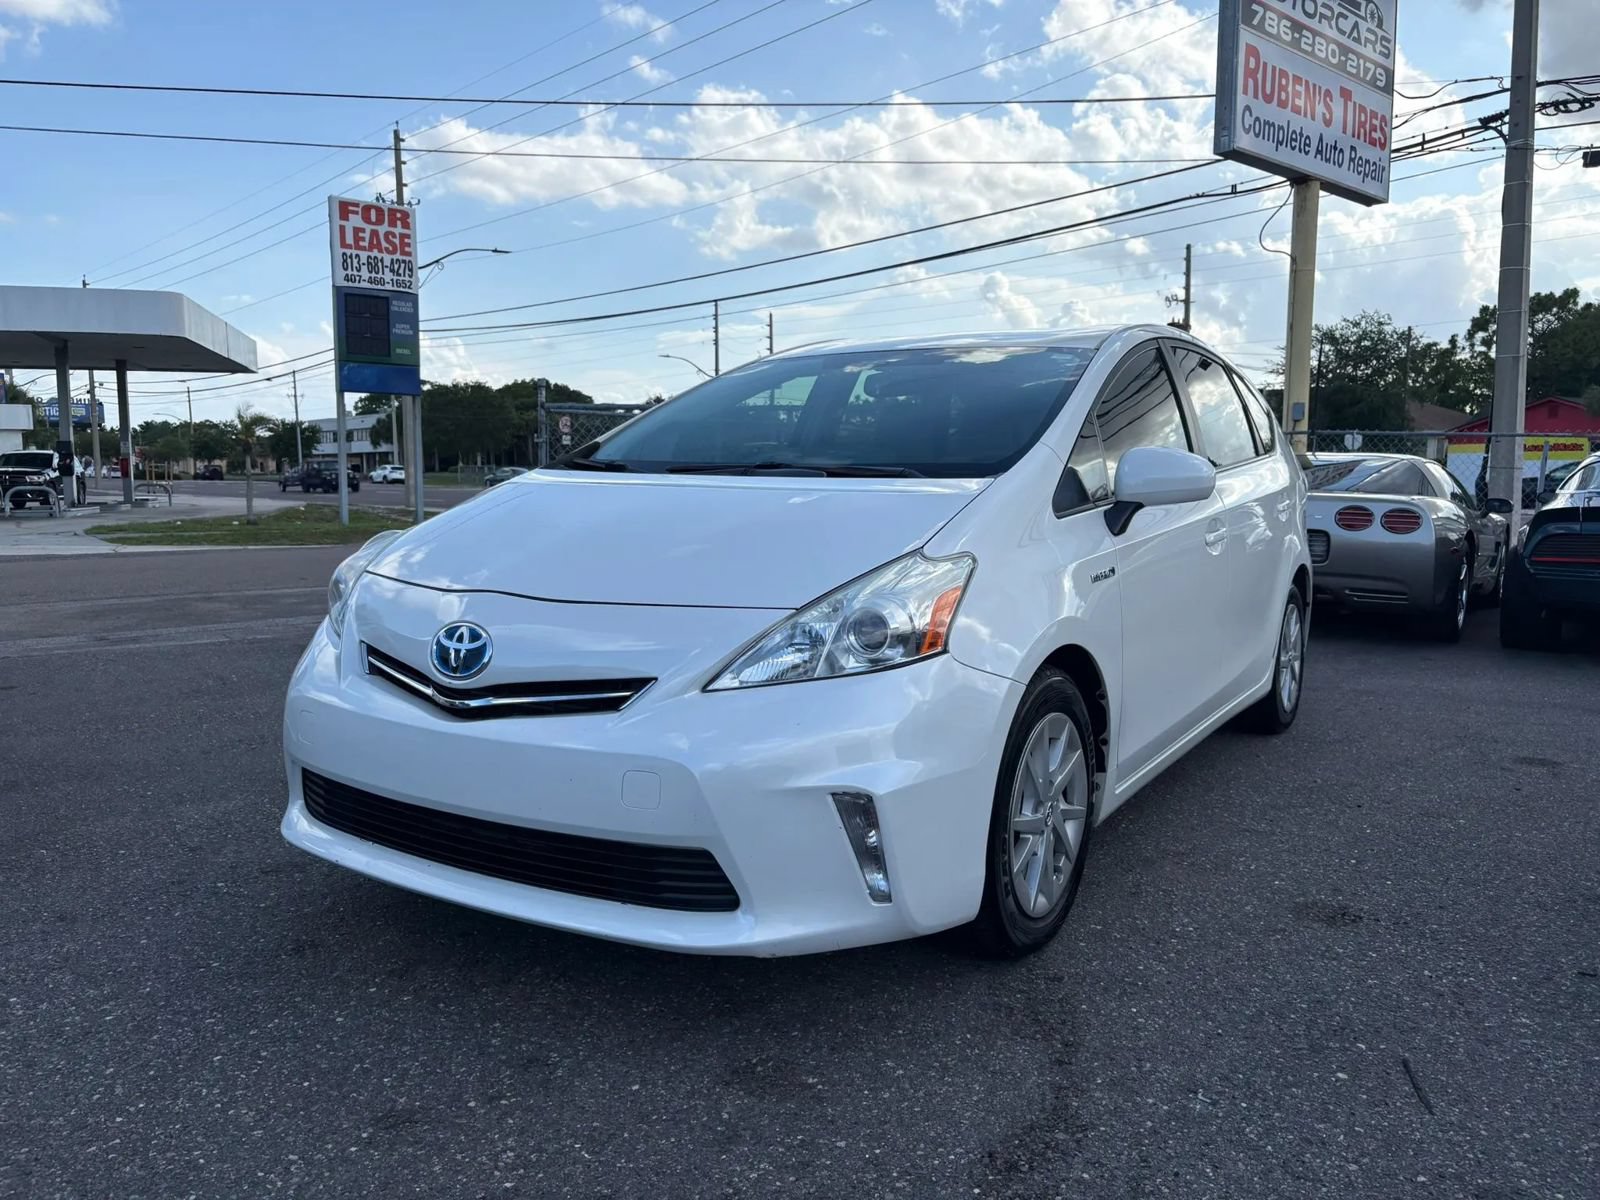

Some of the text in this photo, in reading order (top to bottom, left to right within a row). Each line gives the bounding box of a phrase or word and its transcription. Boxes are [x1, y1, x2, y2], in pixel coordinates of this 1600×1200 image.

[1251, 5, 1387, 88] 786-280-2179
[1277, 0, 1392, 60] ORCARS
[1242, 42, 1388, 152] RUBEN'S TIRES
[1241, 104, 1386, 185] Complete Auto Repair
[338, 200, 411, 230] FOR
[339, 224, 412, 257] LEASE
[341, 252, 414, 279] 813-681-4279
[343, 272, 413, 290] 407-460-1652
